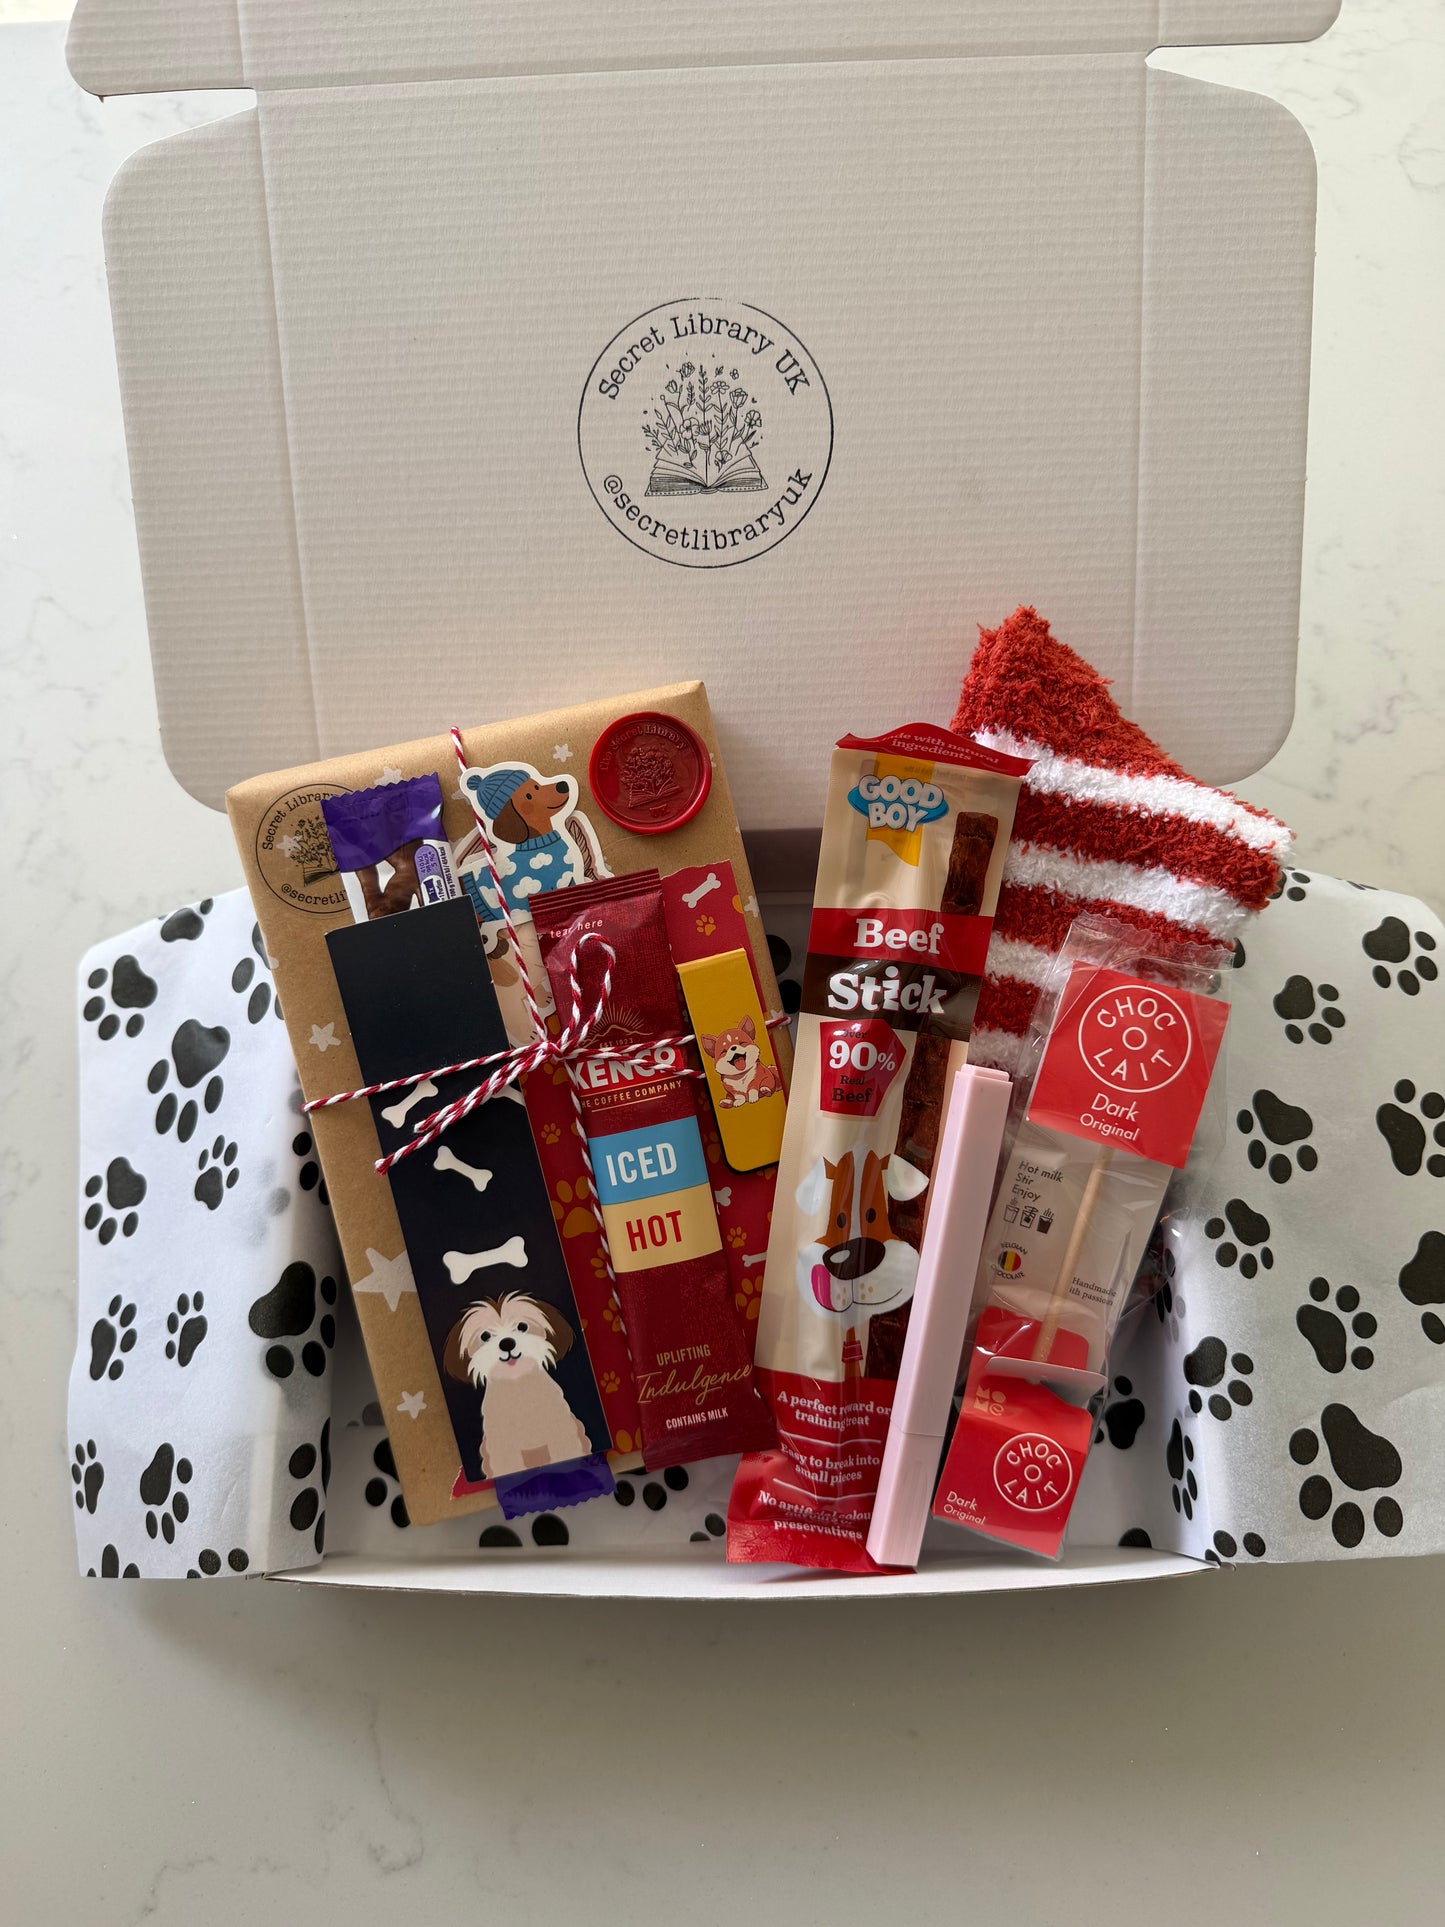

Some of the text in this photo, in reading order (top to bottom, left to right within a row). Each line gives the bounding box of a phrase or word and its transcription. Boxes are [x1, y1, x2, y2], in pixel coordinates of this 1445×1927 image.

[598, 313, 810, 400] Secret Library UK
[603, 468, 813, 551] @secretlibraryuk
[892, 739, 972, 761] ingredients
[913, 734, 946, 747] with
[948, 743, 999, 764] natural
[858, 774, 945, 810] GOOD
[262, 792, 334, 851] Secret Librar
[867, 802, 928, 833] BOY
[550, 919, 604, 939] tear here
[853, 918, 945, 954] Beef
[828, 966, 947, 1015] Stick
[1096, 996, 1177, 1031] CHOC
[829, 1040, 896, 1072] 90%
[1093, 1048, 1173, 1082] LAIT
[594, 1091, 632, 1106] COFFEE
[634, 1080, 682, 1098] COMPANY
[840, 1074, 866, 1086] Real
[831, 1087, 873, 1103] Beef
[1090, 1093, 1140, 1122] Dark
[1079, 1113, 1140, 1142] Original
[606, 1142, 678, 1187] ICED
[1018, 1160, 1065, 1184] Hot milk
[1015, 1172, 1035, 1186] Stir
[1011, 1184, 1041, 1202] Enjoy
[625, 1210, 683, 1252] HOT
[1069, 1286, 1114, 1307] ith passion
[1072, 1276, 1117, 1297] Handmade
[656, 1344, 711, 1366] UPLIFTING
[636, 1364, 753, 1406] Indulgence
[777, 1391, 789, 1402] A
[790, 1394, 837, 1415] perfect
[665, 1407, 729, 1430] CONTAINS MILK
[795, 1409, 870, 1432] training treat
[781, 1442, 881, 1470] Easy to break into
[1006, 1441, 1062, 1469] CHOC
[795, 1465, 863, 1486] small pieces
[758, 1490, 777, 1506] No
[946, 1490, 978, 1511] Dark
[1003, 1479, 1059, 1505] LAIT
[943, 1503, 986, 1526] Original
[773, 1519, 863, 1540] preservatives
